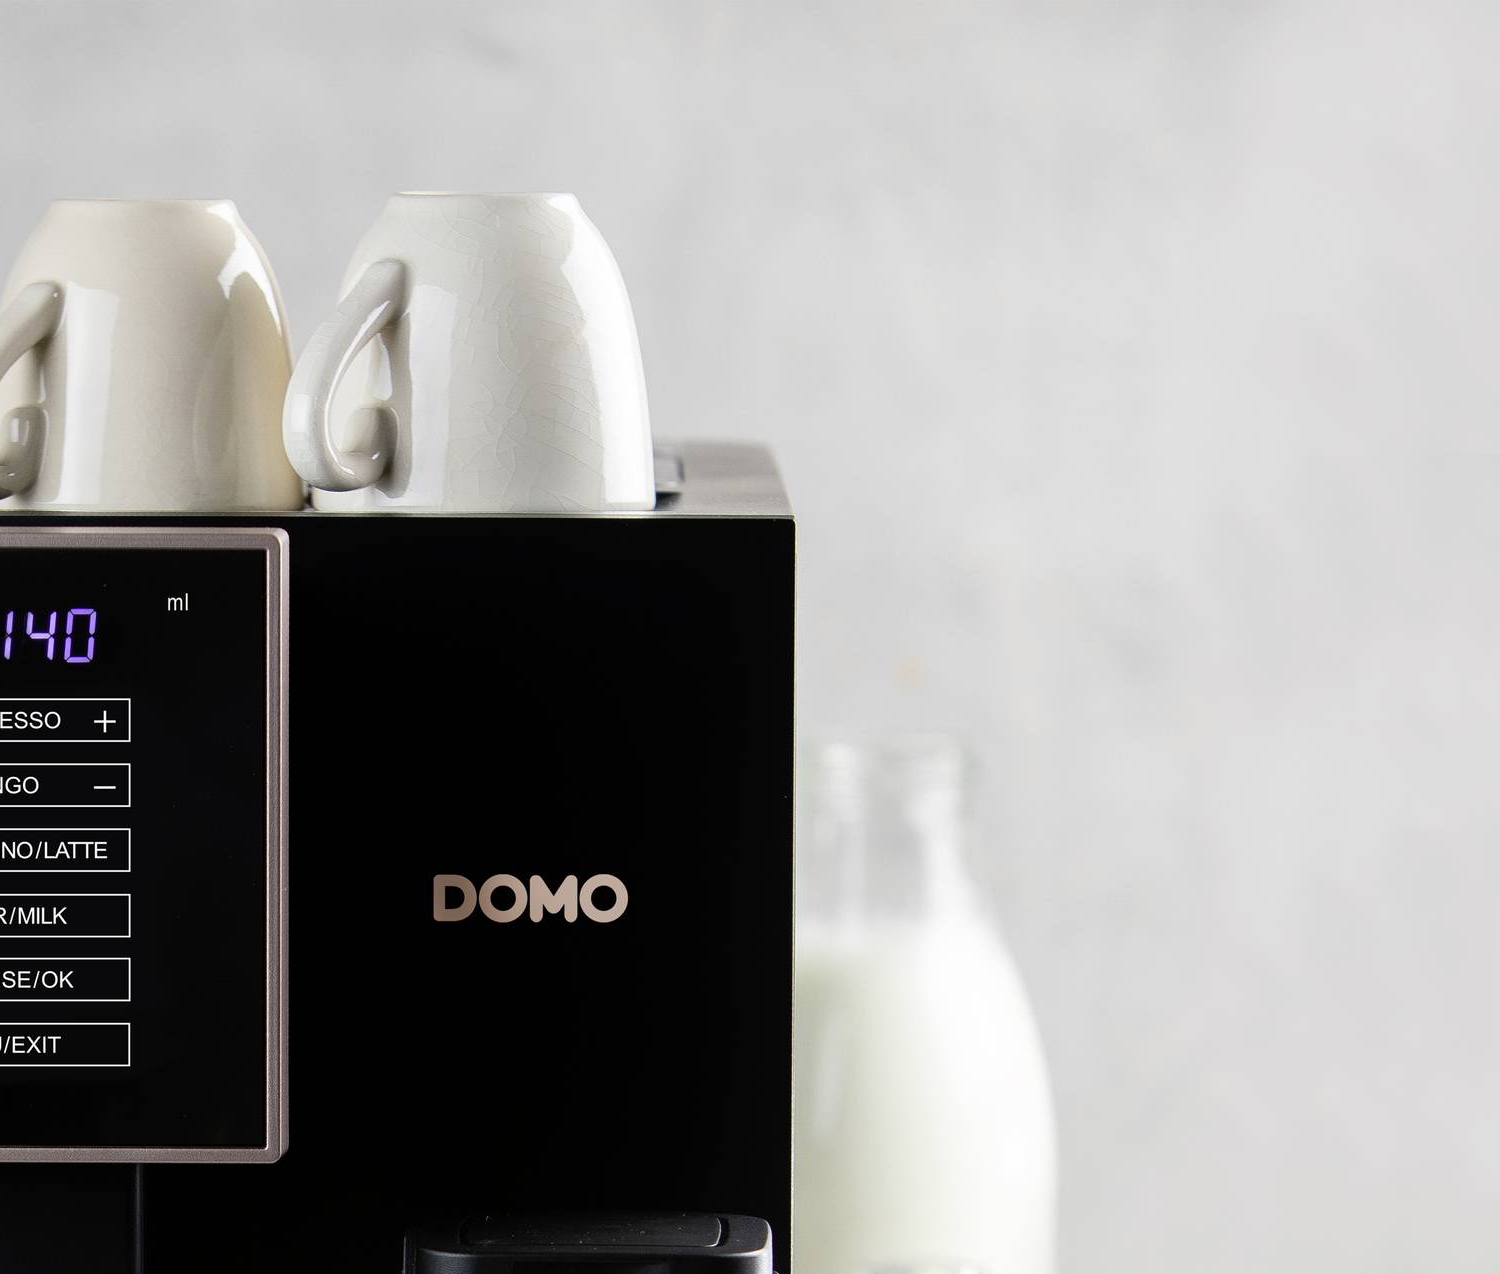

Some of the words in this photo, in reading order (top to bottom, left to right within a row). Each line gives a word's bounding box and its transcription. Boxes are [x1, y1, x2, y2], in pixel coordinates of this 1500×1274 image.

[168, 593, 188, 611] ml
[4, 608, 96, 663] 140
[433, 874, 628, 923] DOMO
